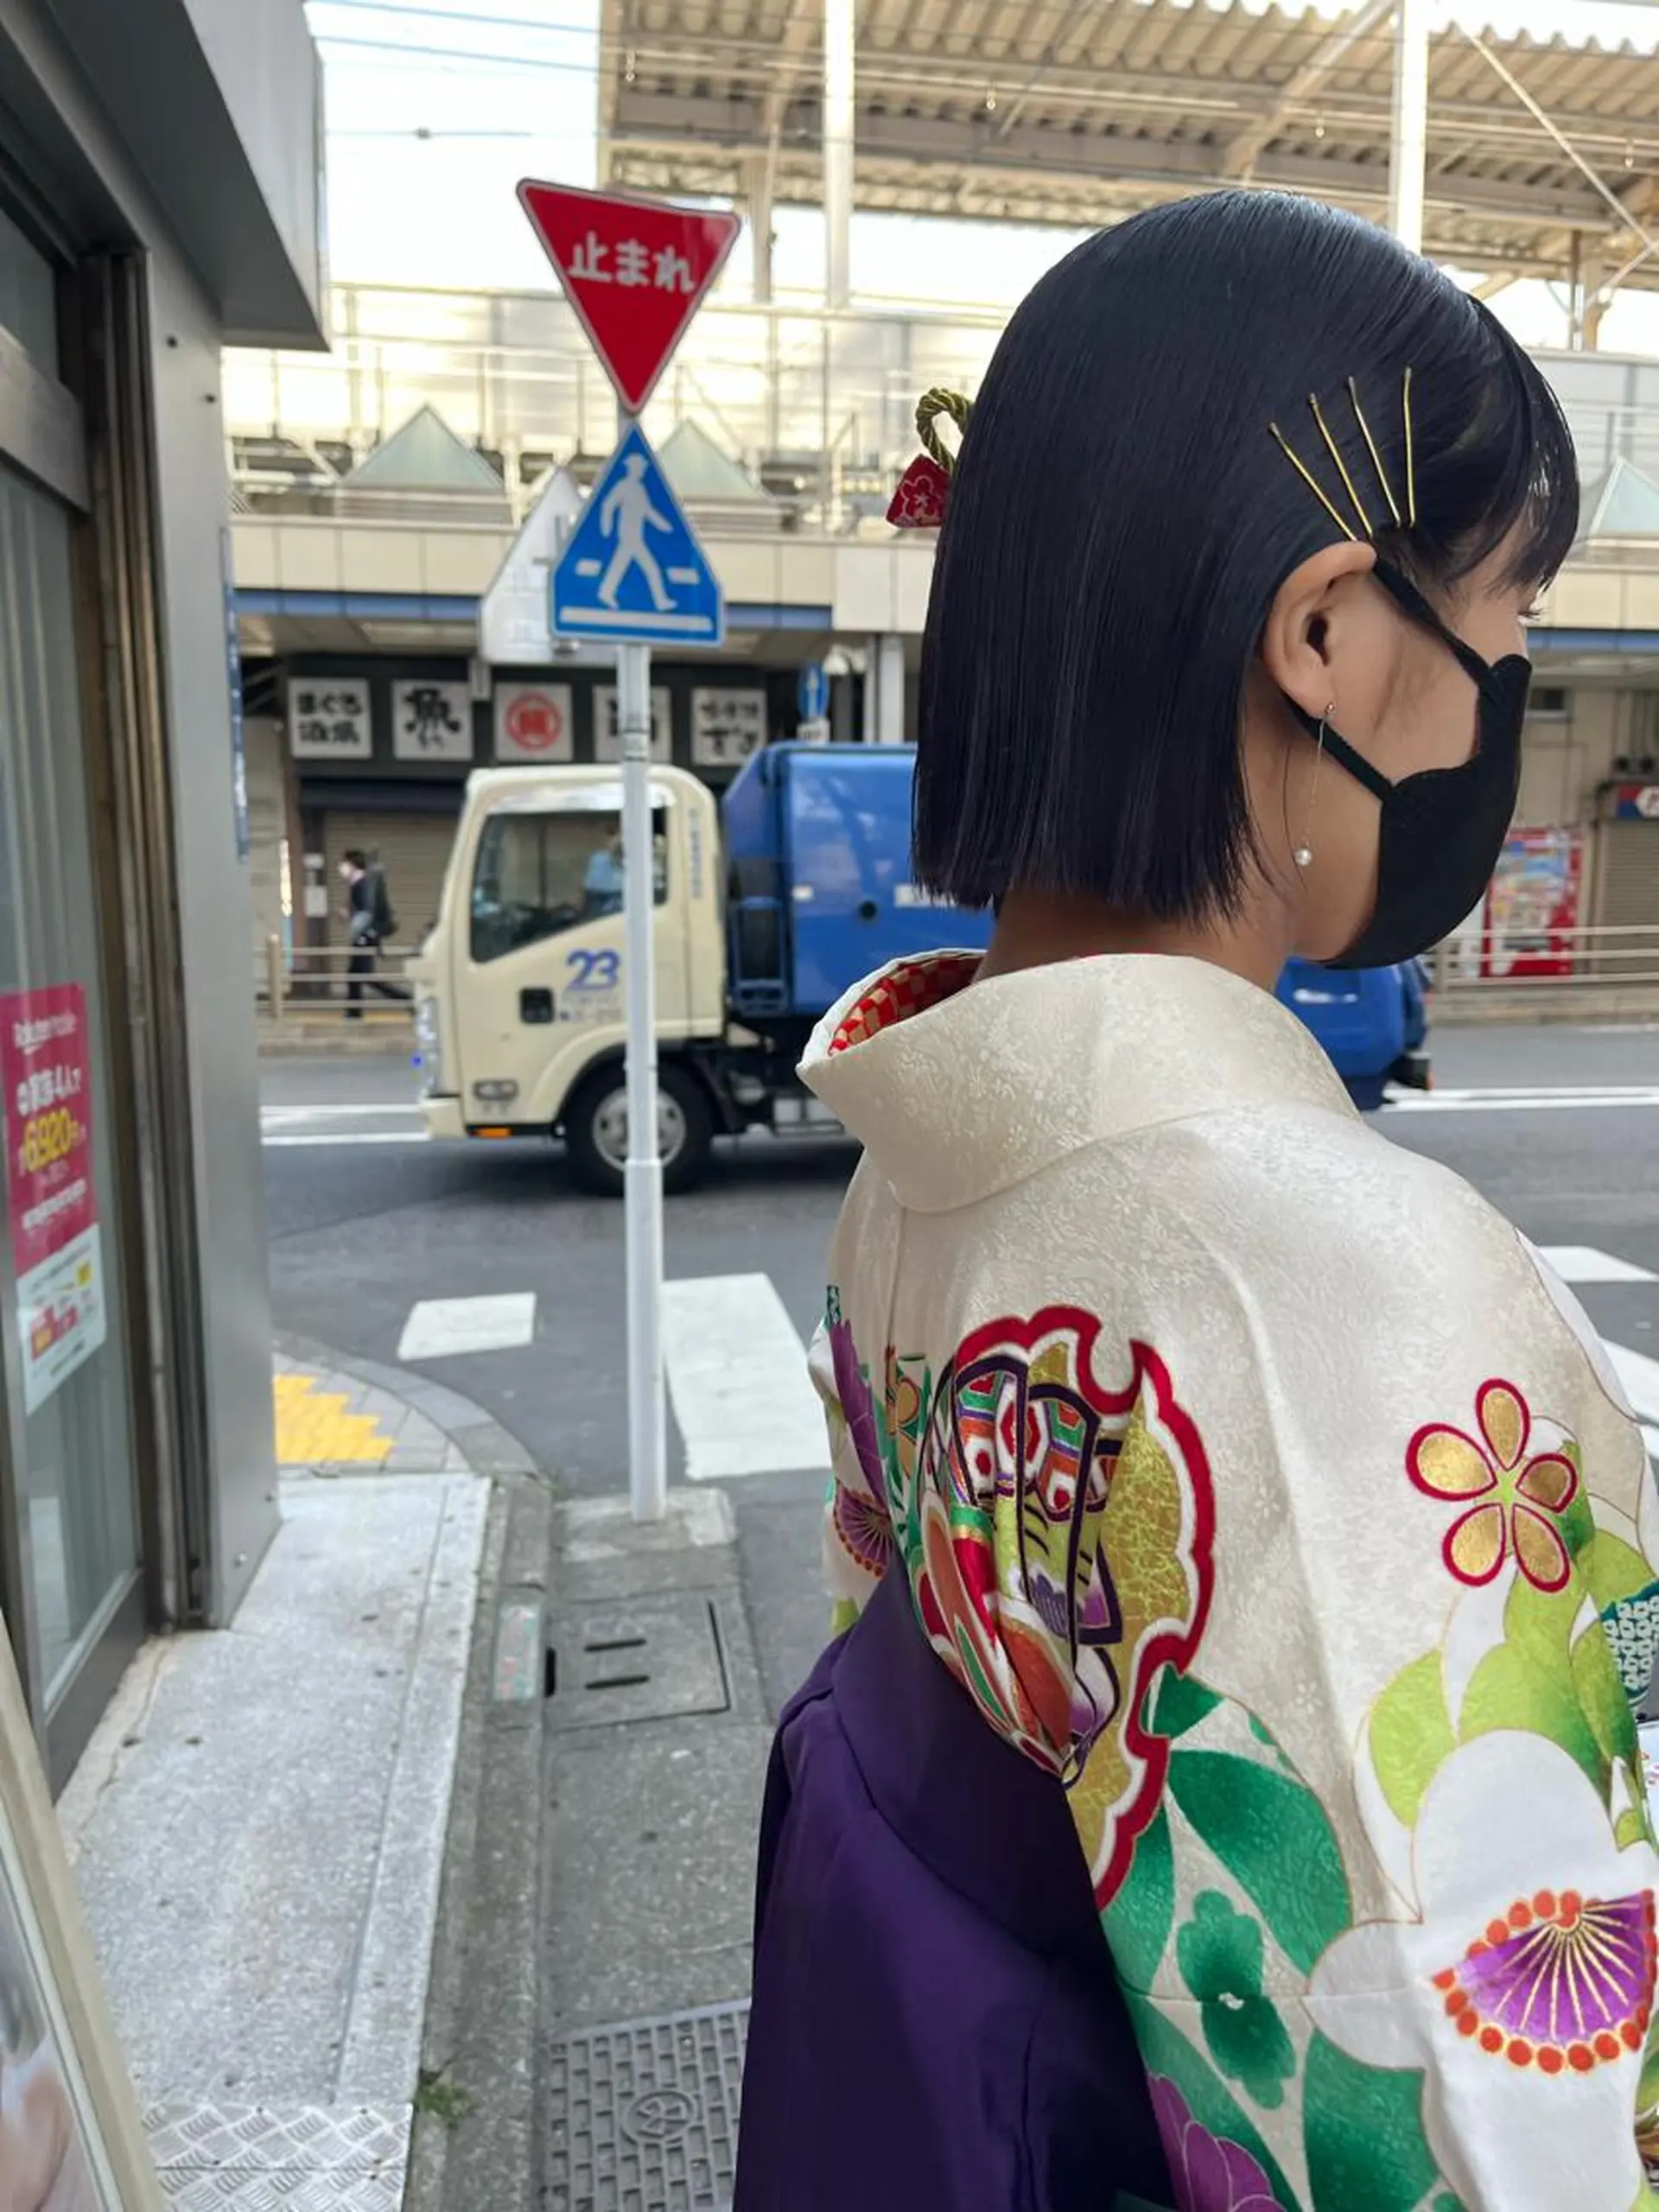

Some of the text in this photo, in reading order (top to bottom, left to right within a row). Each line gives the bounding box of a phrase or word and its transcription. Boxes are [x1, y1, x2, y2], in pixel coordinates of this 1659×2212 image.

[567, 230, 695, 294] 止まれ
[566, 950, 620, 991] 23
